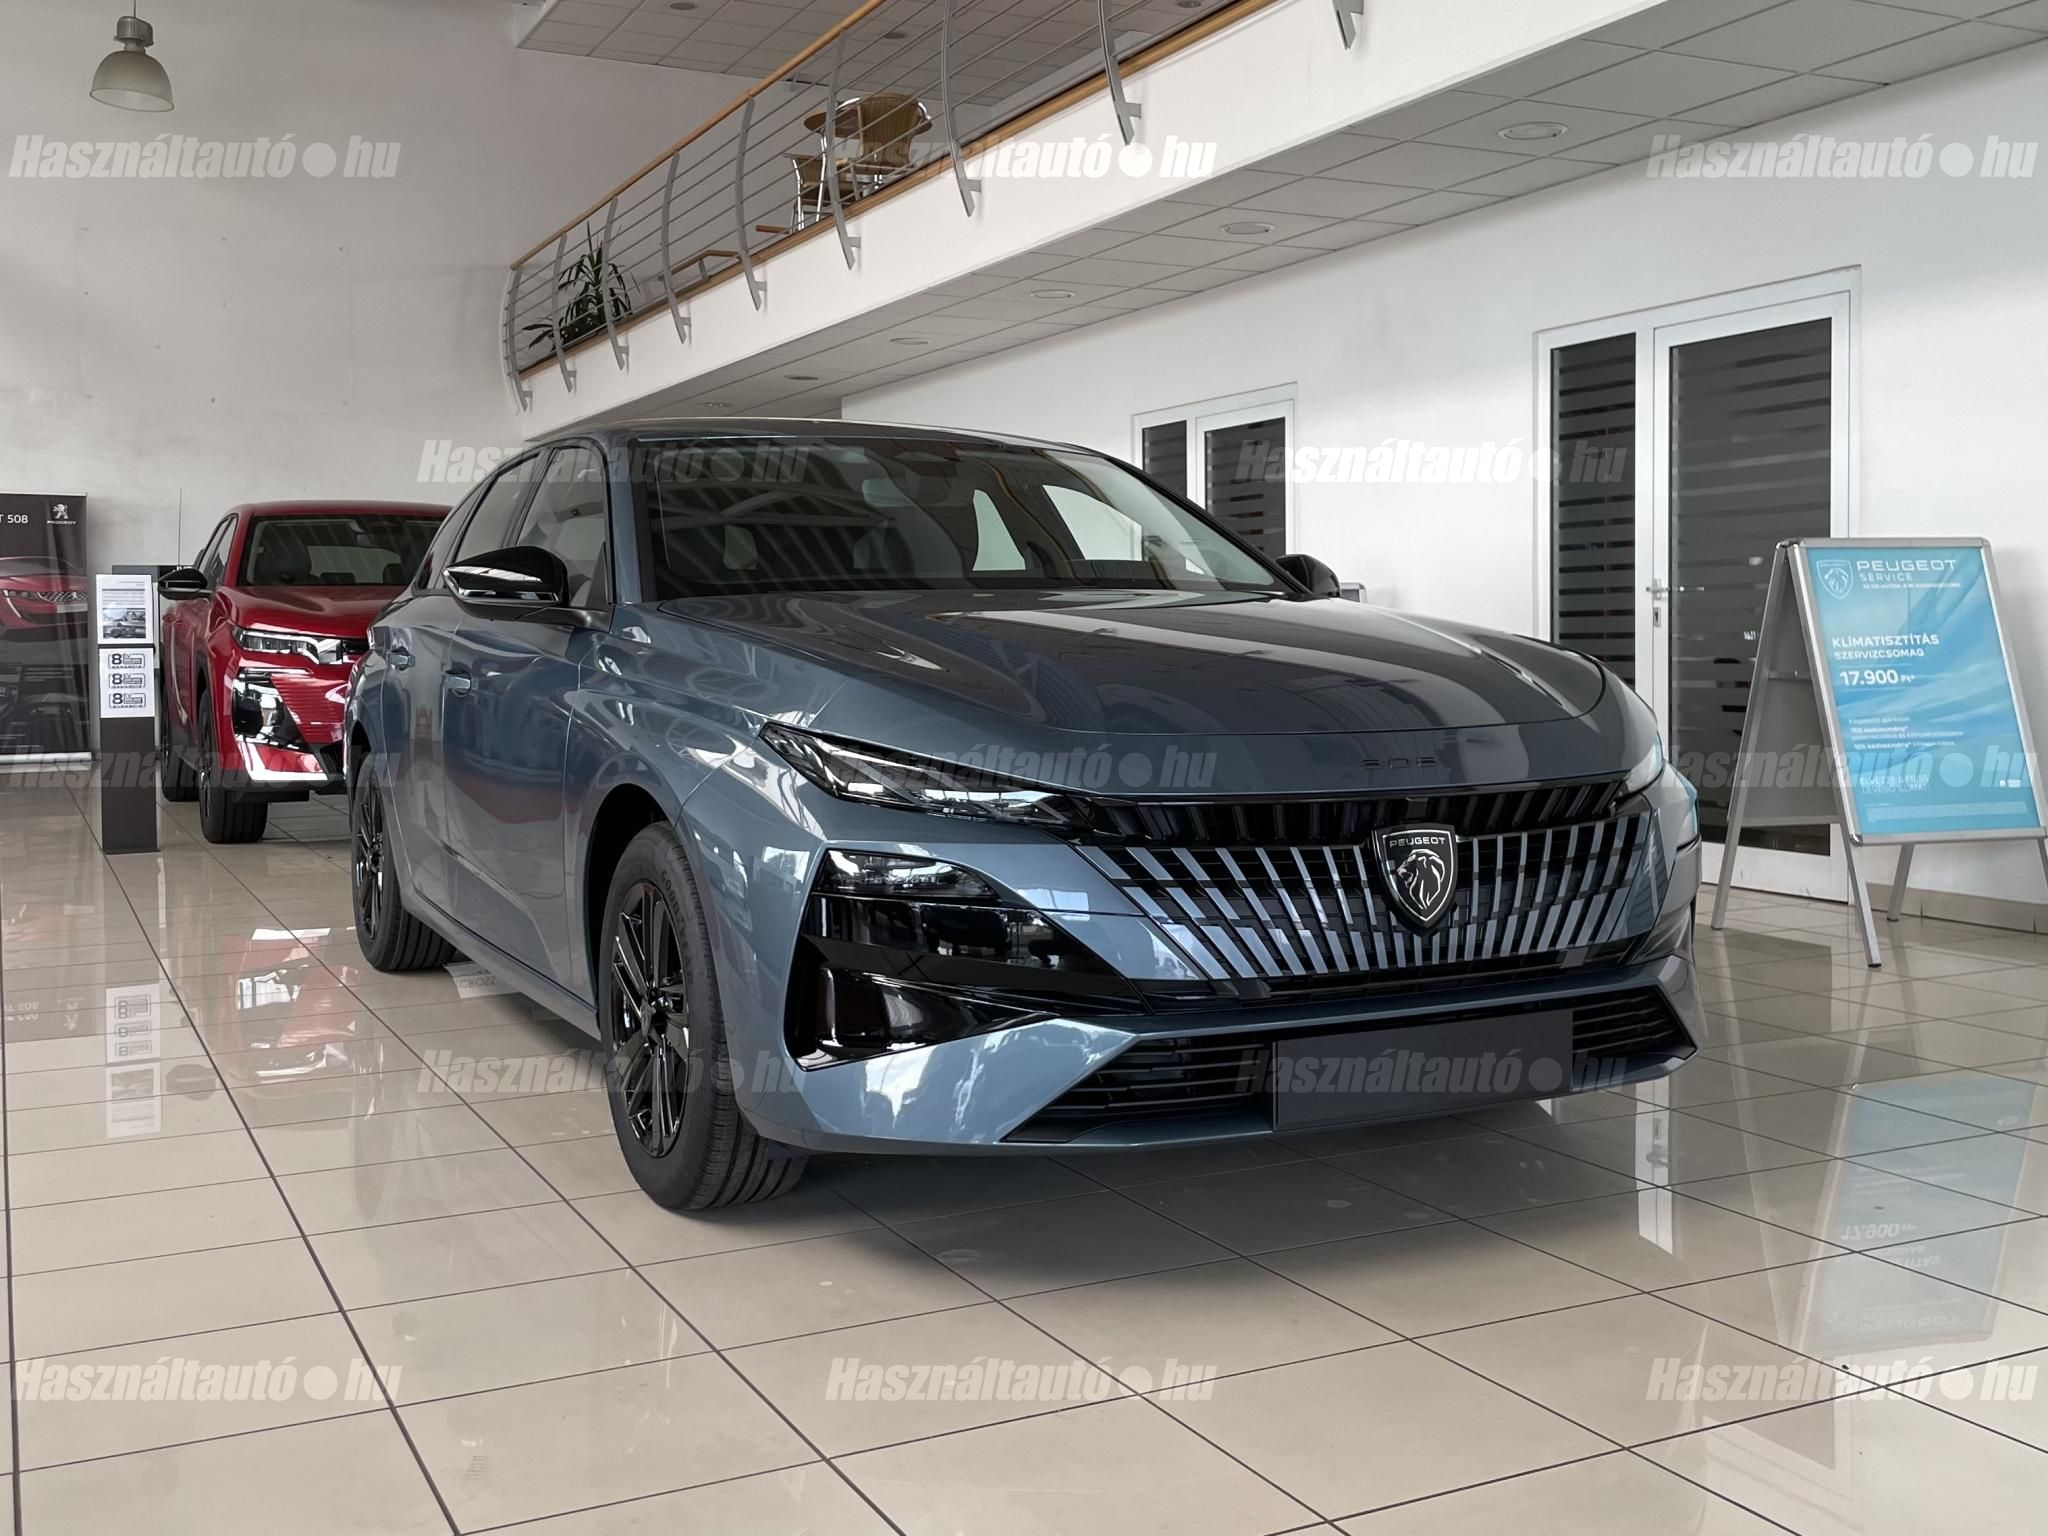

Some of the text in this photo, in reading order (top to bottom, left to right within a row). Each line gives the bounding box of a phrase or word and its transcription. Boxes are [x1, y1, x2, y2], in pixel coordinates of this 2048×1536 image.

[7, 514, 29, 524] 508
[1856, 559, 1957, 572] PEUGEOT
[1859, 572, 1913, 582] SERVICE
[1831, 632, 1940, 649] KLÍMATISZTÍTÁS
[112, 653, 123, 664] 8
[1834, 648, 1925, 660] SZERVIZCSOMAG
[112, 673, 123, 685] 8
[1839, 669, 1899, 686] 17.900
[112, 692, 123, 704] 8
[1389, 836, 1446, 847] PEUGEOT
